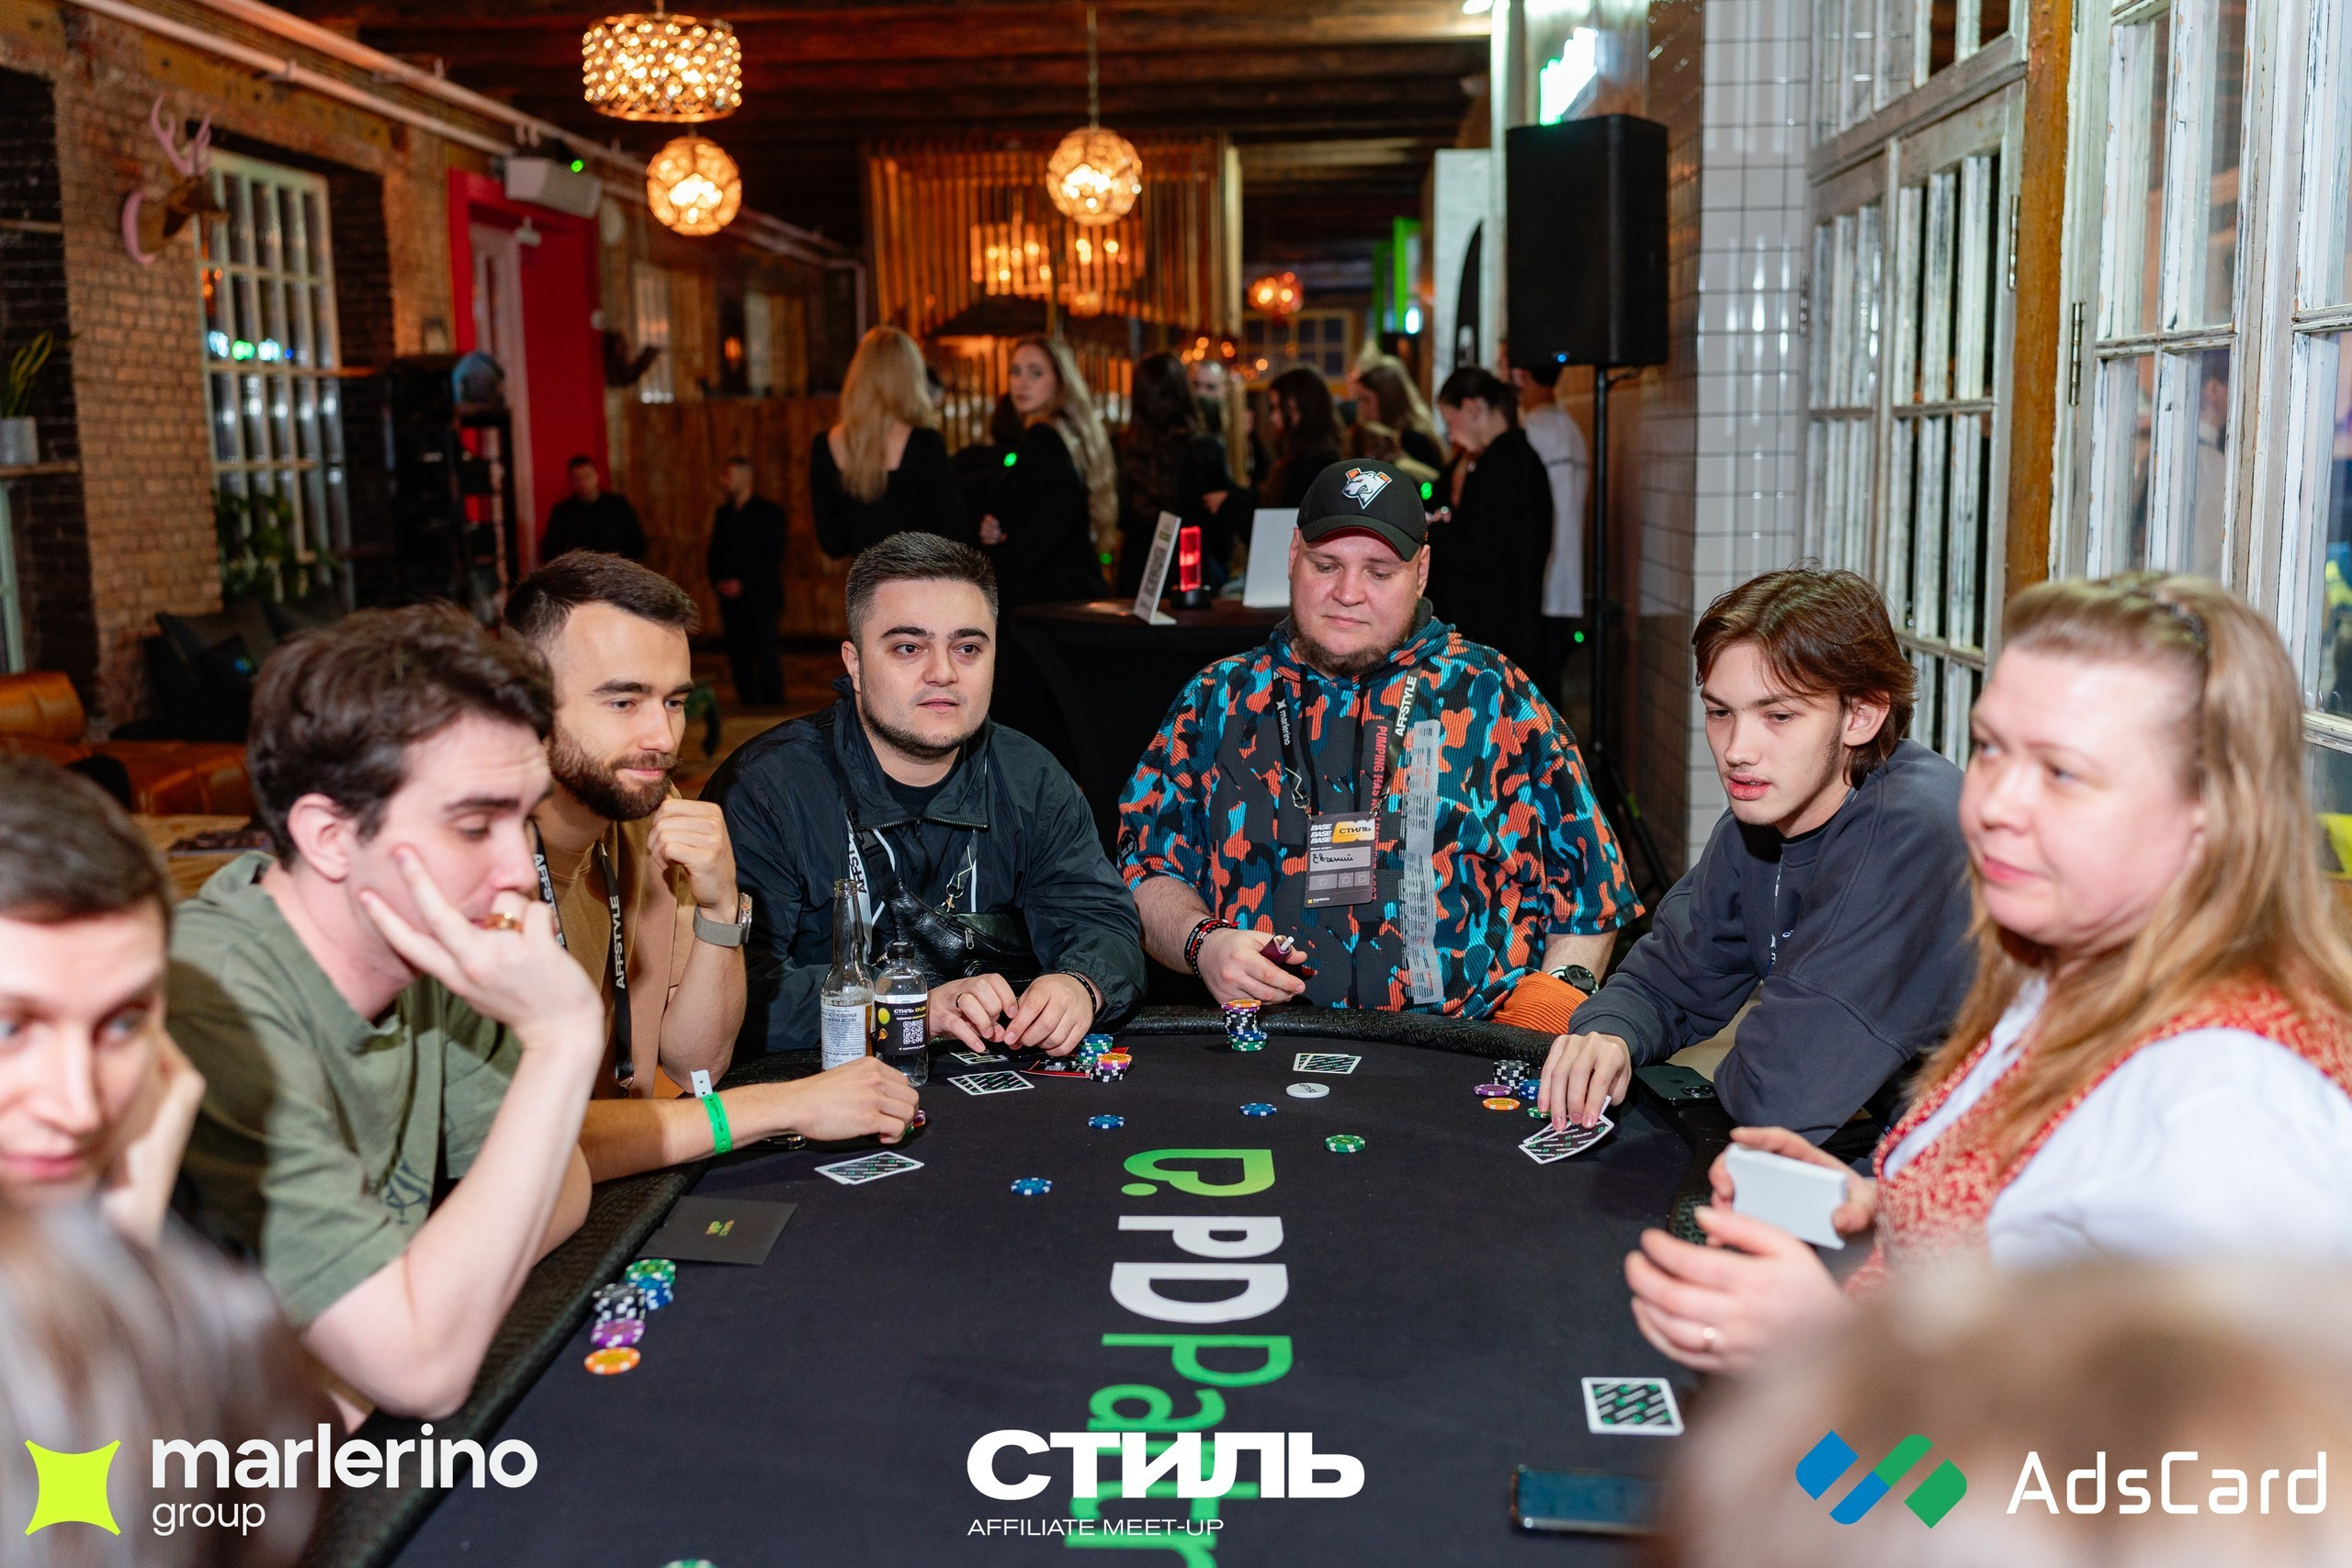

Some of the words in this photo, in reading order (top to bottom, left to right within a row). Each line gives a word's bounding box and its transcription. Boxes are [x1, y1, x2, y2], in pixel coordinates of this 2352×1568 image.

[1280, 709, 1291, 746] marlerino
[1395, 676, 1418, 738] AFFSTYLE
[1373, 725, 1388, 773] PUMPING
[1372, 773, 1384, 797] HAS
[1310, 823, 1332, 831] BASE
[1339, 827, 1372, 835] СТИЛЬ
[609, 895, 626, 989] AFFSTYLE
[1109, 1215, 1289, 1324] PD
